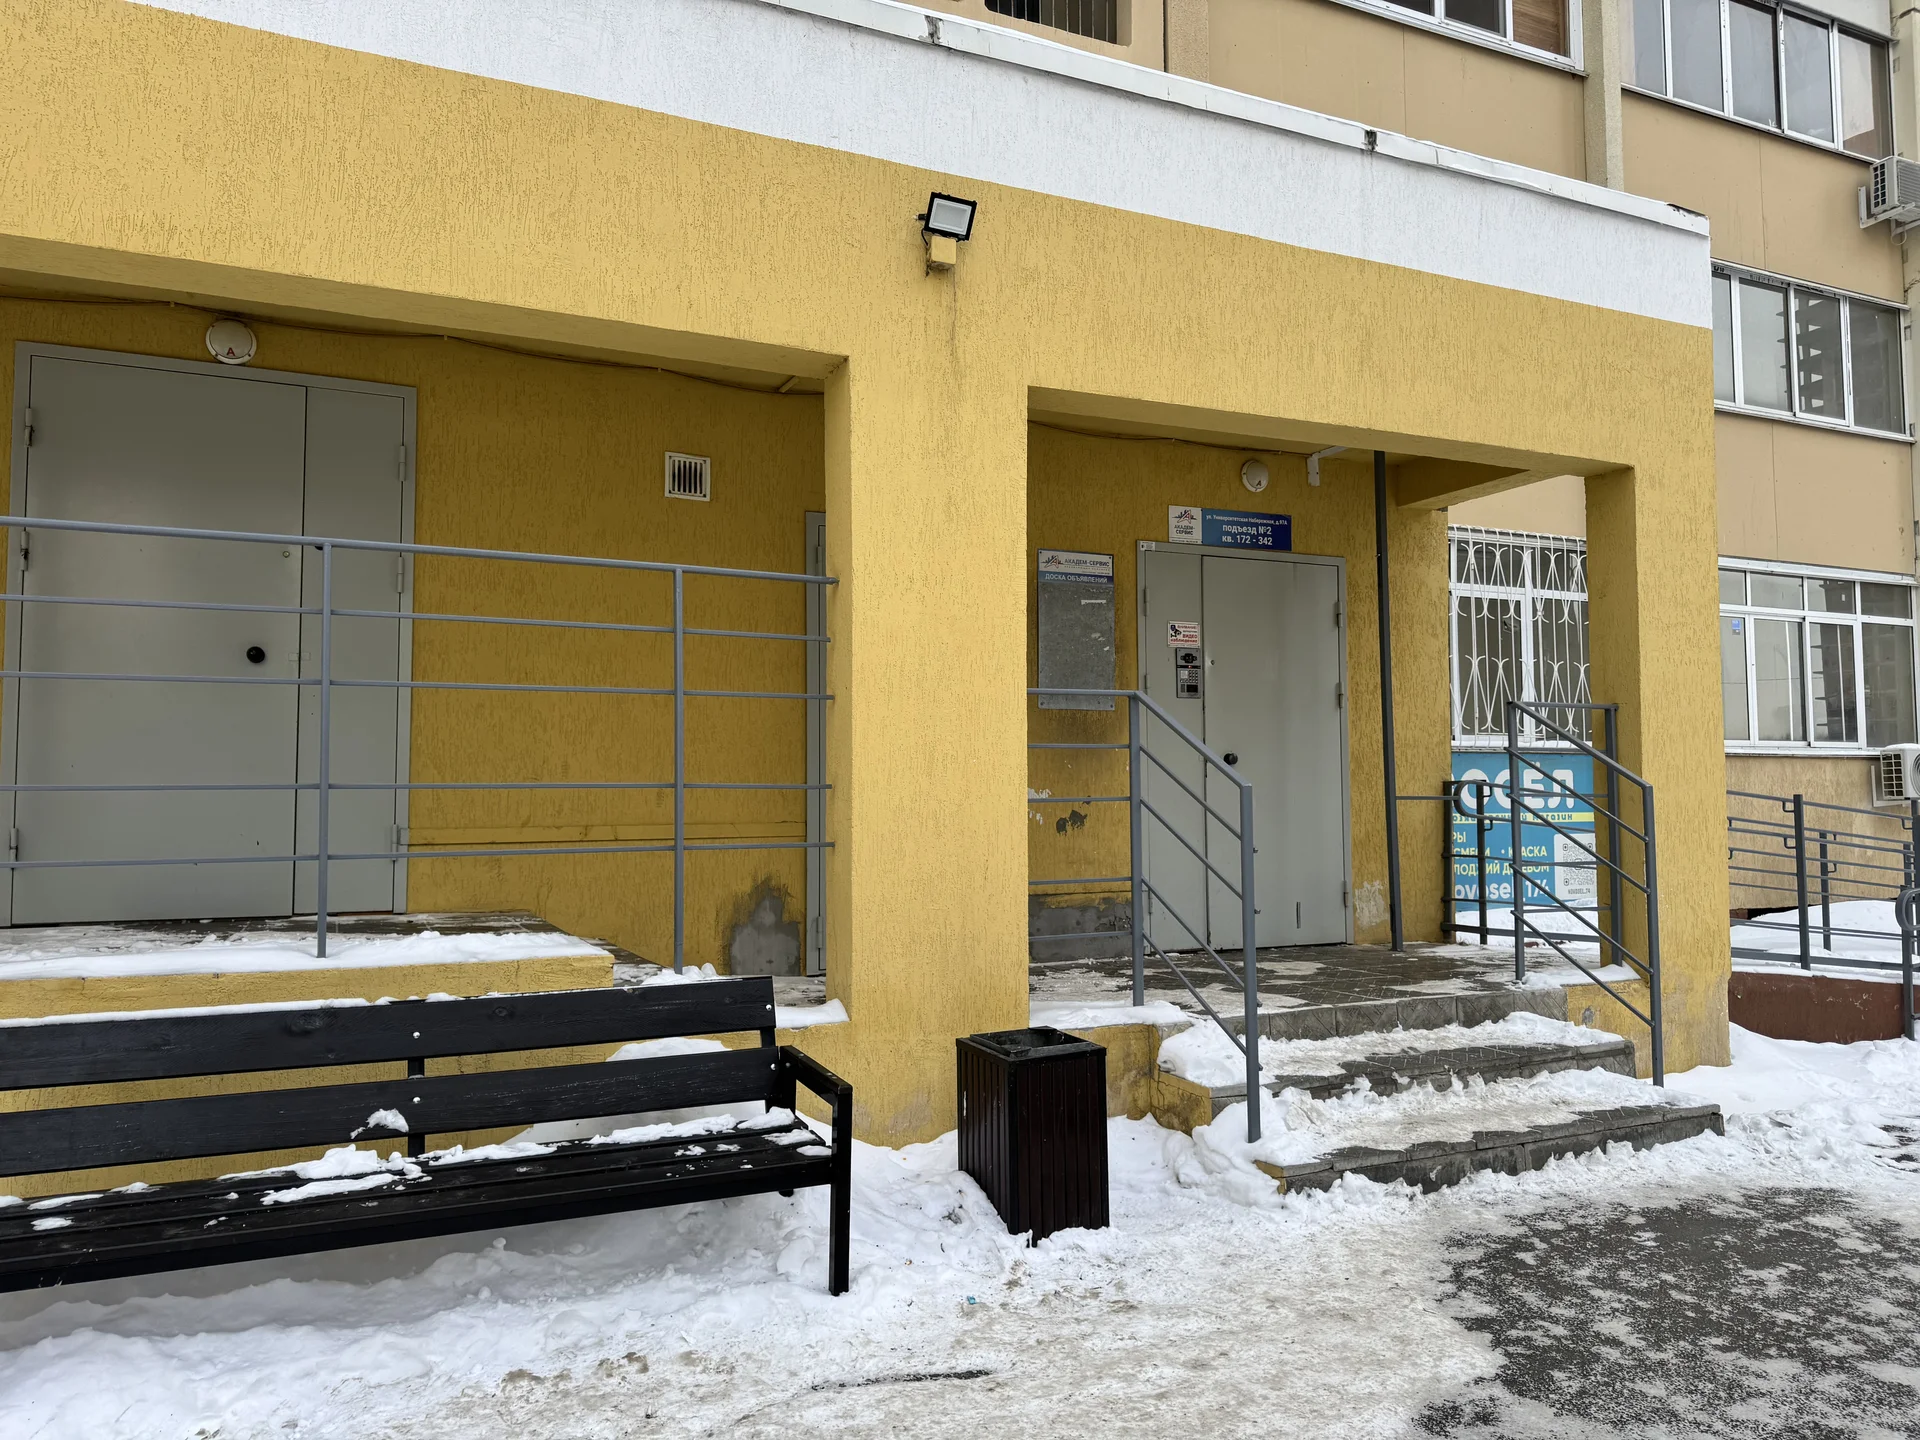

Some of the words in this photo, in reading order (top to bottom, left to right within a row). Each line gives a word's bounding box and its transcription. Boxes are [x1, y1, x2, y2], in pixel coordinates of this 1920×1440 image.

[1222, 525, 1258, 535] подъезд
[1222, 535, 1235, 543] кв.
[1236, 535, 1251, 544] 172
[1258, 536, 1273, 546] 342
[1064, 558, 1110, 567] АКАДЕМ-СЕРВИС
[1045, 573, 1066, 581] ДОСКА
[1067, 574, 1108, 583] ОБЪЯВЛЕНИЙ
[1451, 761, 1574, 809] ОСЁЛ
[1508, 846, 1548, 858] КАСКА
[1454, 860, 1500, 877] ЛОДИЙ
[1502, 861, 1550, 876] ДЕВОМ
